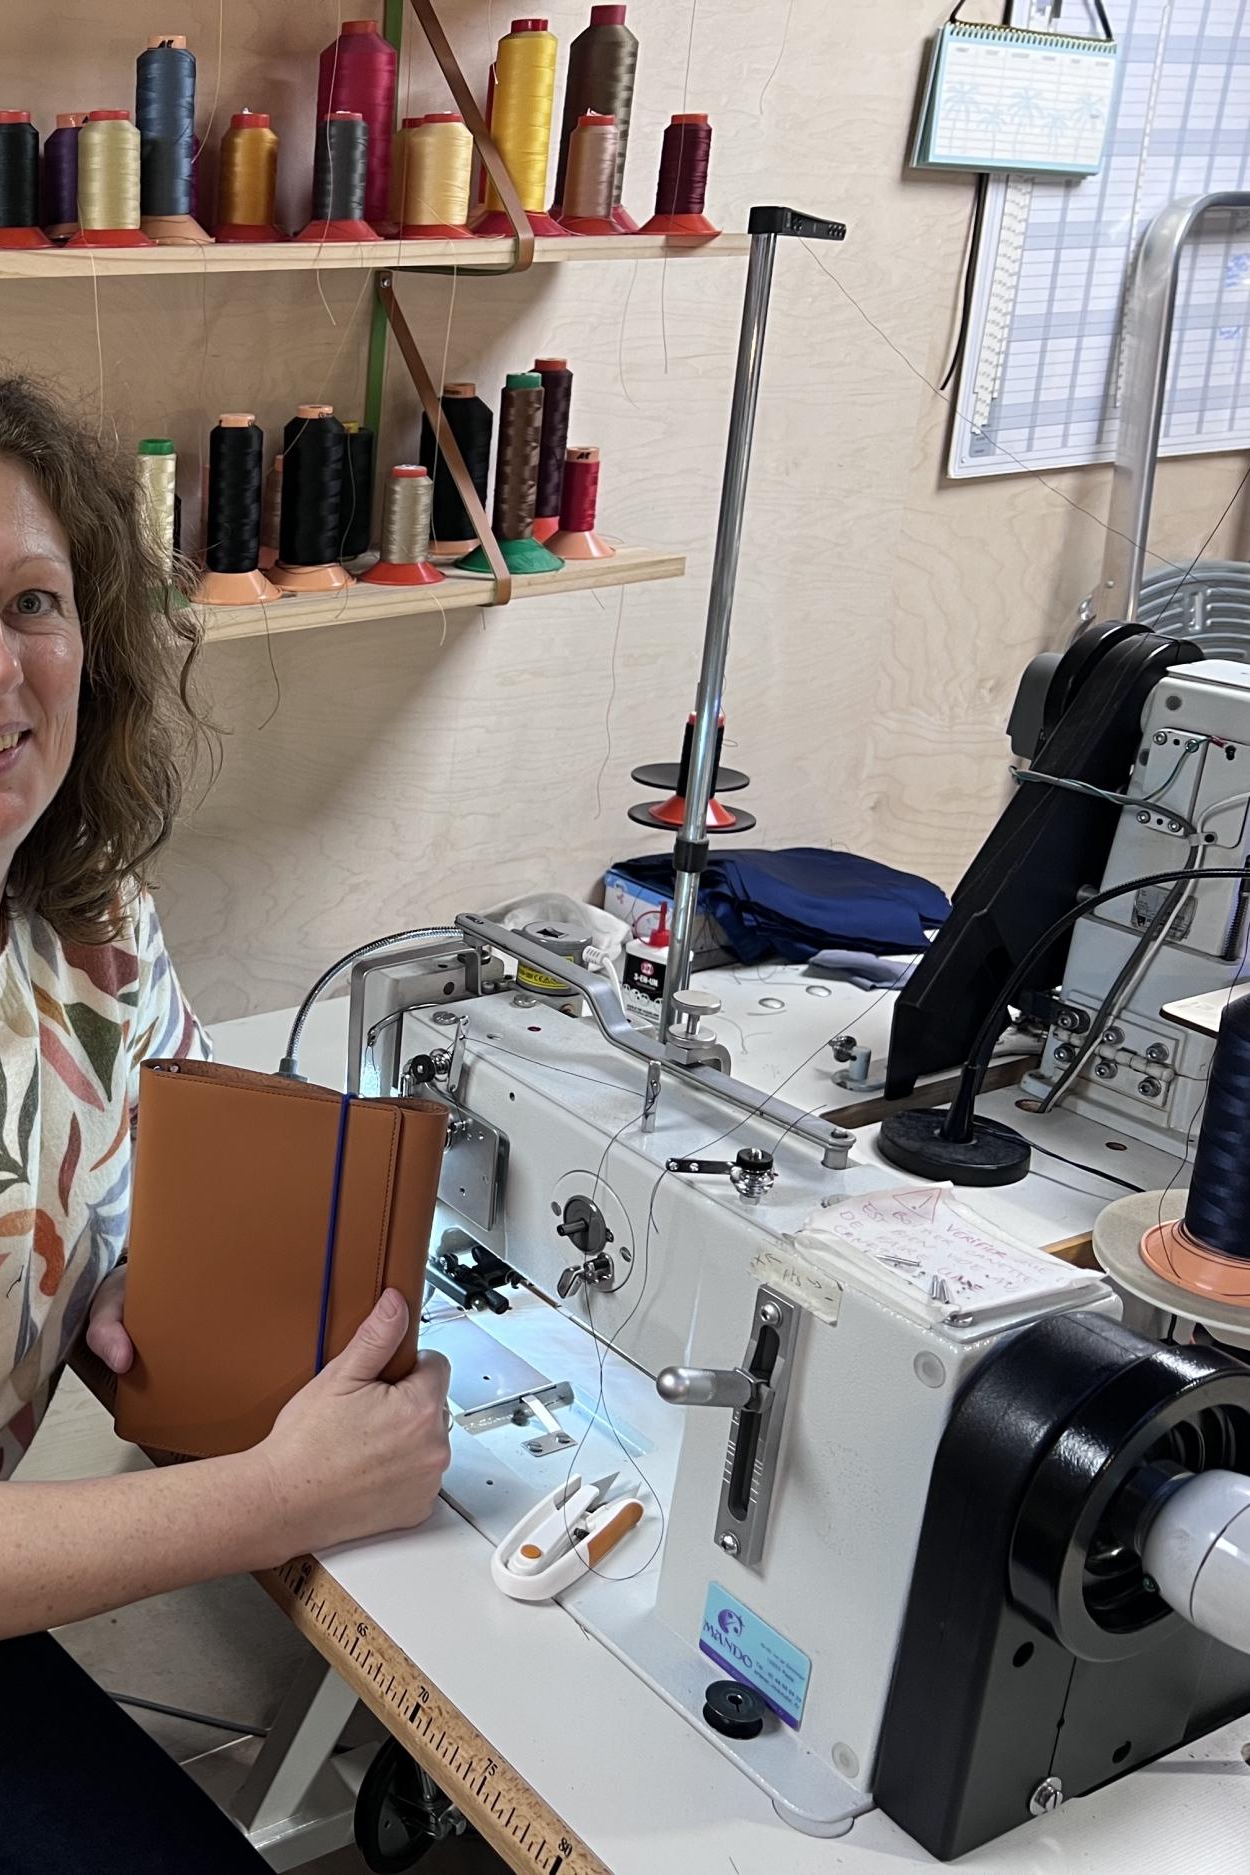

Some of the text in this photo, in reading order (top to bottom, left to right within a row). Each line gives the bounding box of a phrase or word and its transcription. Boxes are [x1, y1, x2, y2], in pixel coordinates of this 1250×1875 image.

[839, 1211, 863, 1230] DE
[356, 1622, 369, 1637] 65
[703, 1618, 753, 1669] MANDO
[417, 1685, 430, 1704] 70
[485, 1757, 498, 1776] 75
[558, 1837, 572, 1857] 80
